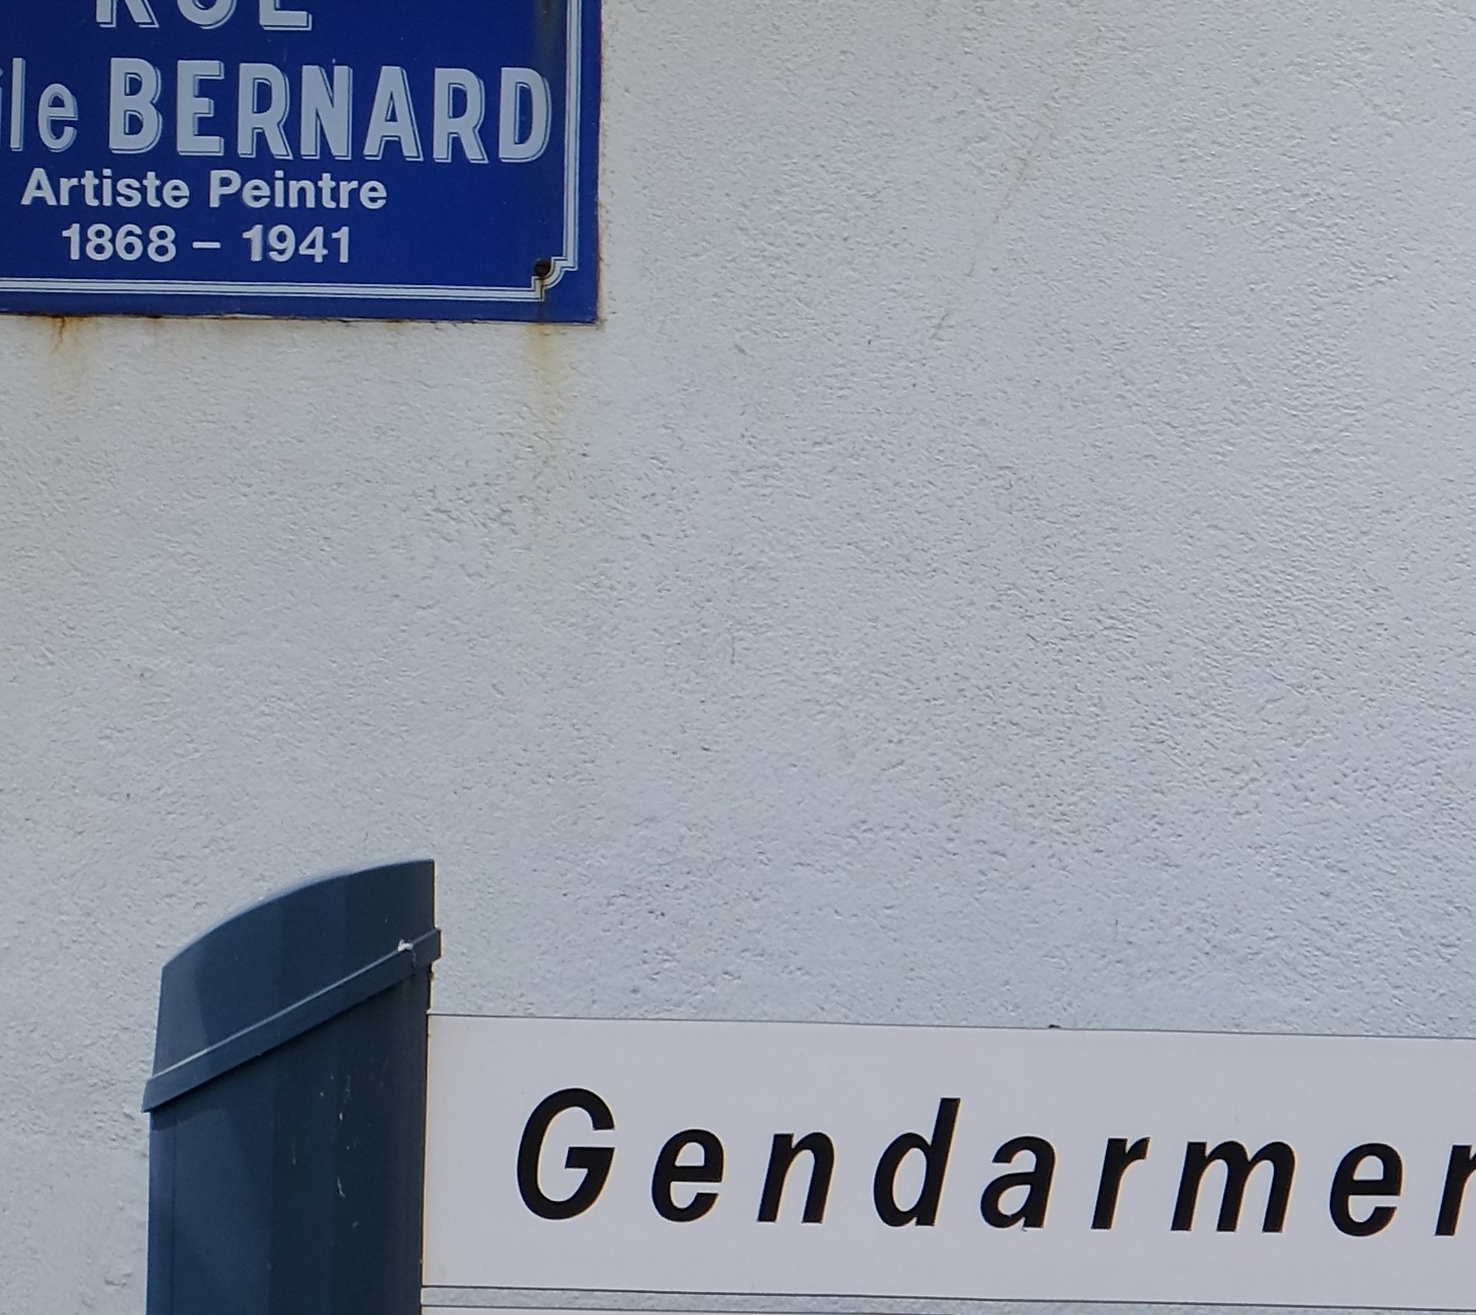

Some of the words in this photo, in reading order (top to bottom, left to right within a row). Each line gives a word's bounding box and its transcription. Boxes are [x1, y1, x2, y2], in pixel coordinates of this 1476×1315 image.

[108, 57, 552, 164] BERNARD
[21, 167, 190, 209] Artiste
[209, 169, 387, 210] Peintre
[61, 223, 177, 263] 1868
[242, 224, 350, 264] 1941
